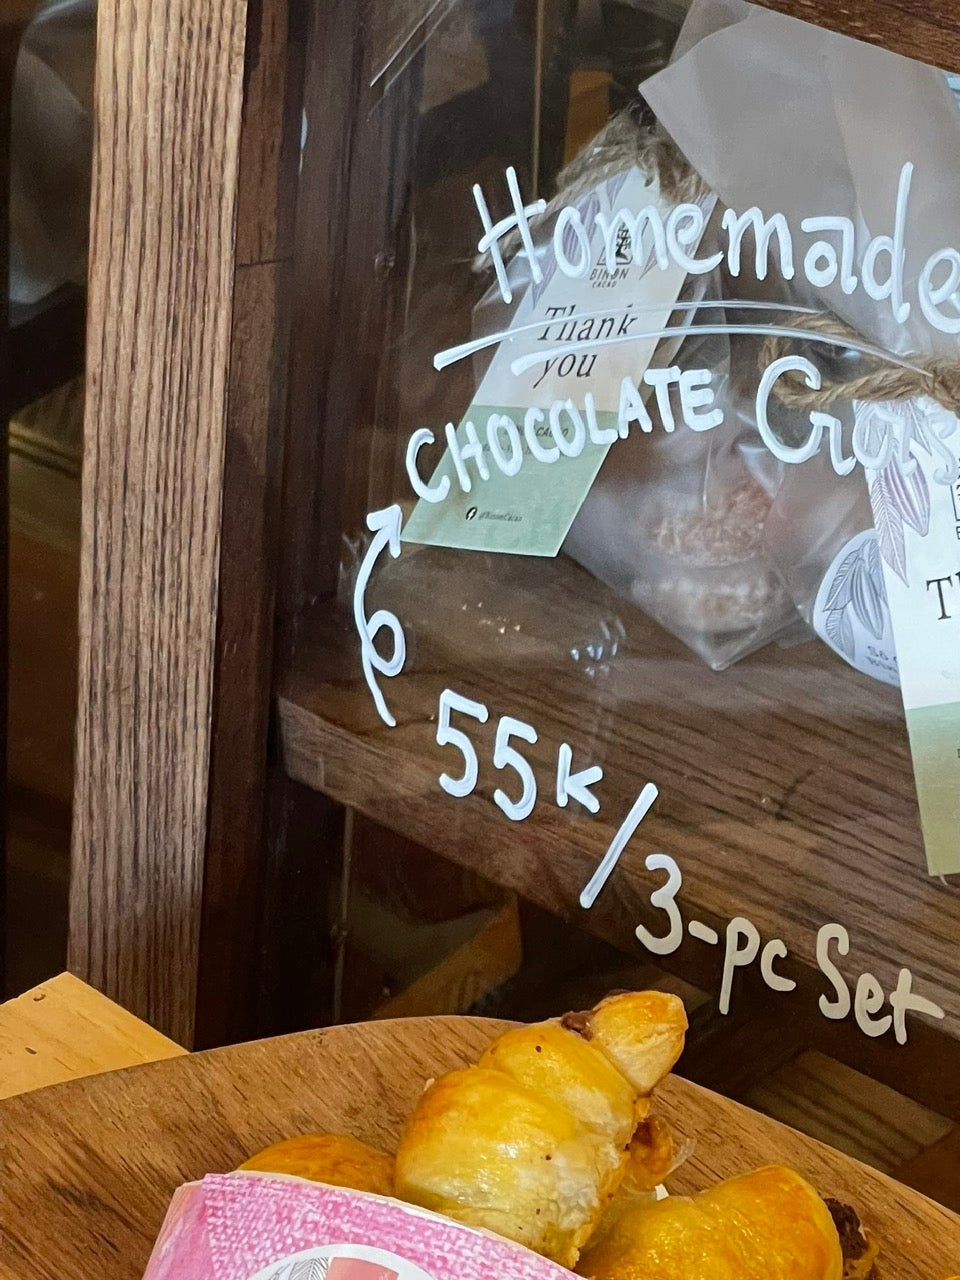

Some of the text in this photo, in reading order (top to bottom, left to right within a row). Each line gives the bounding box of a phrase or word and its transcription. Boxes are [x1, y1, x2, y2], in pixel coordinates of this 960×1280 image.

[537, 303, 640, 342] Thank
[532, 353, 598, 390] you
[405, 364, 724, 503] CHOCOLATE
[816, 923, 946, 1045] Set
